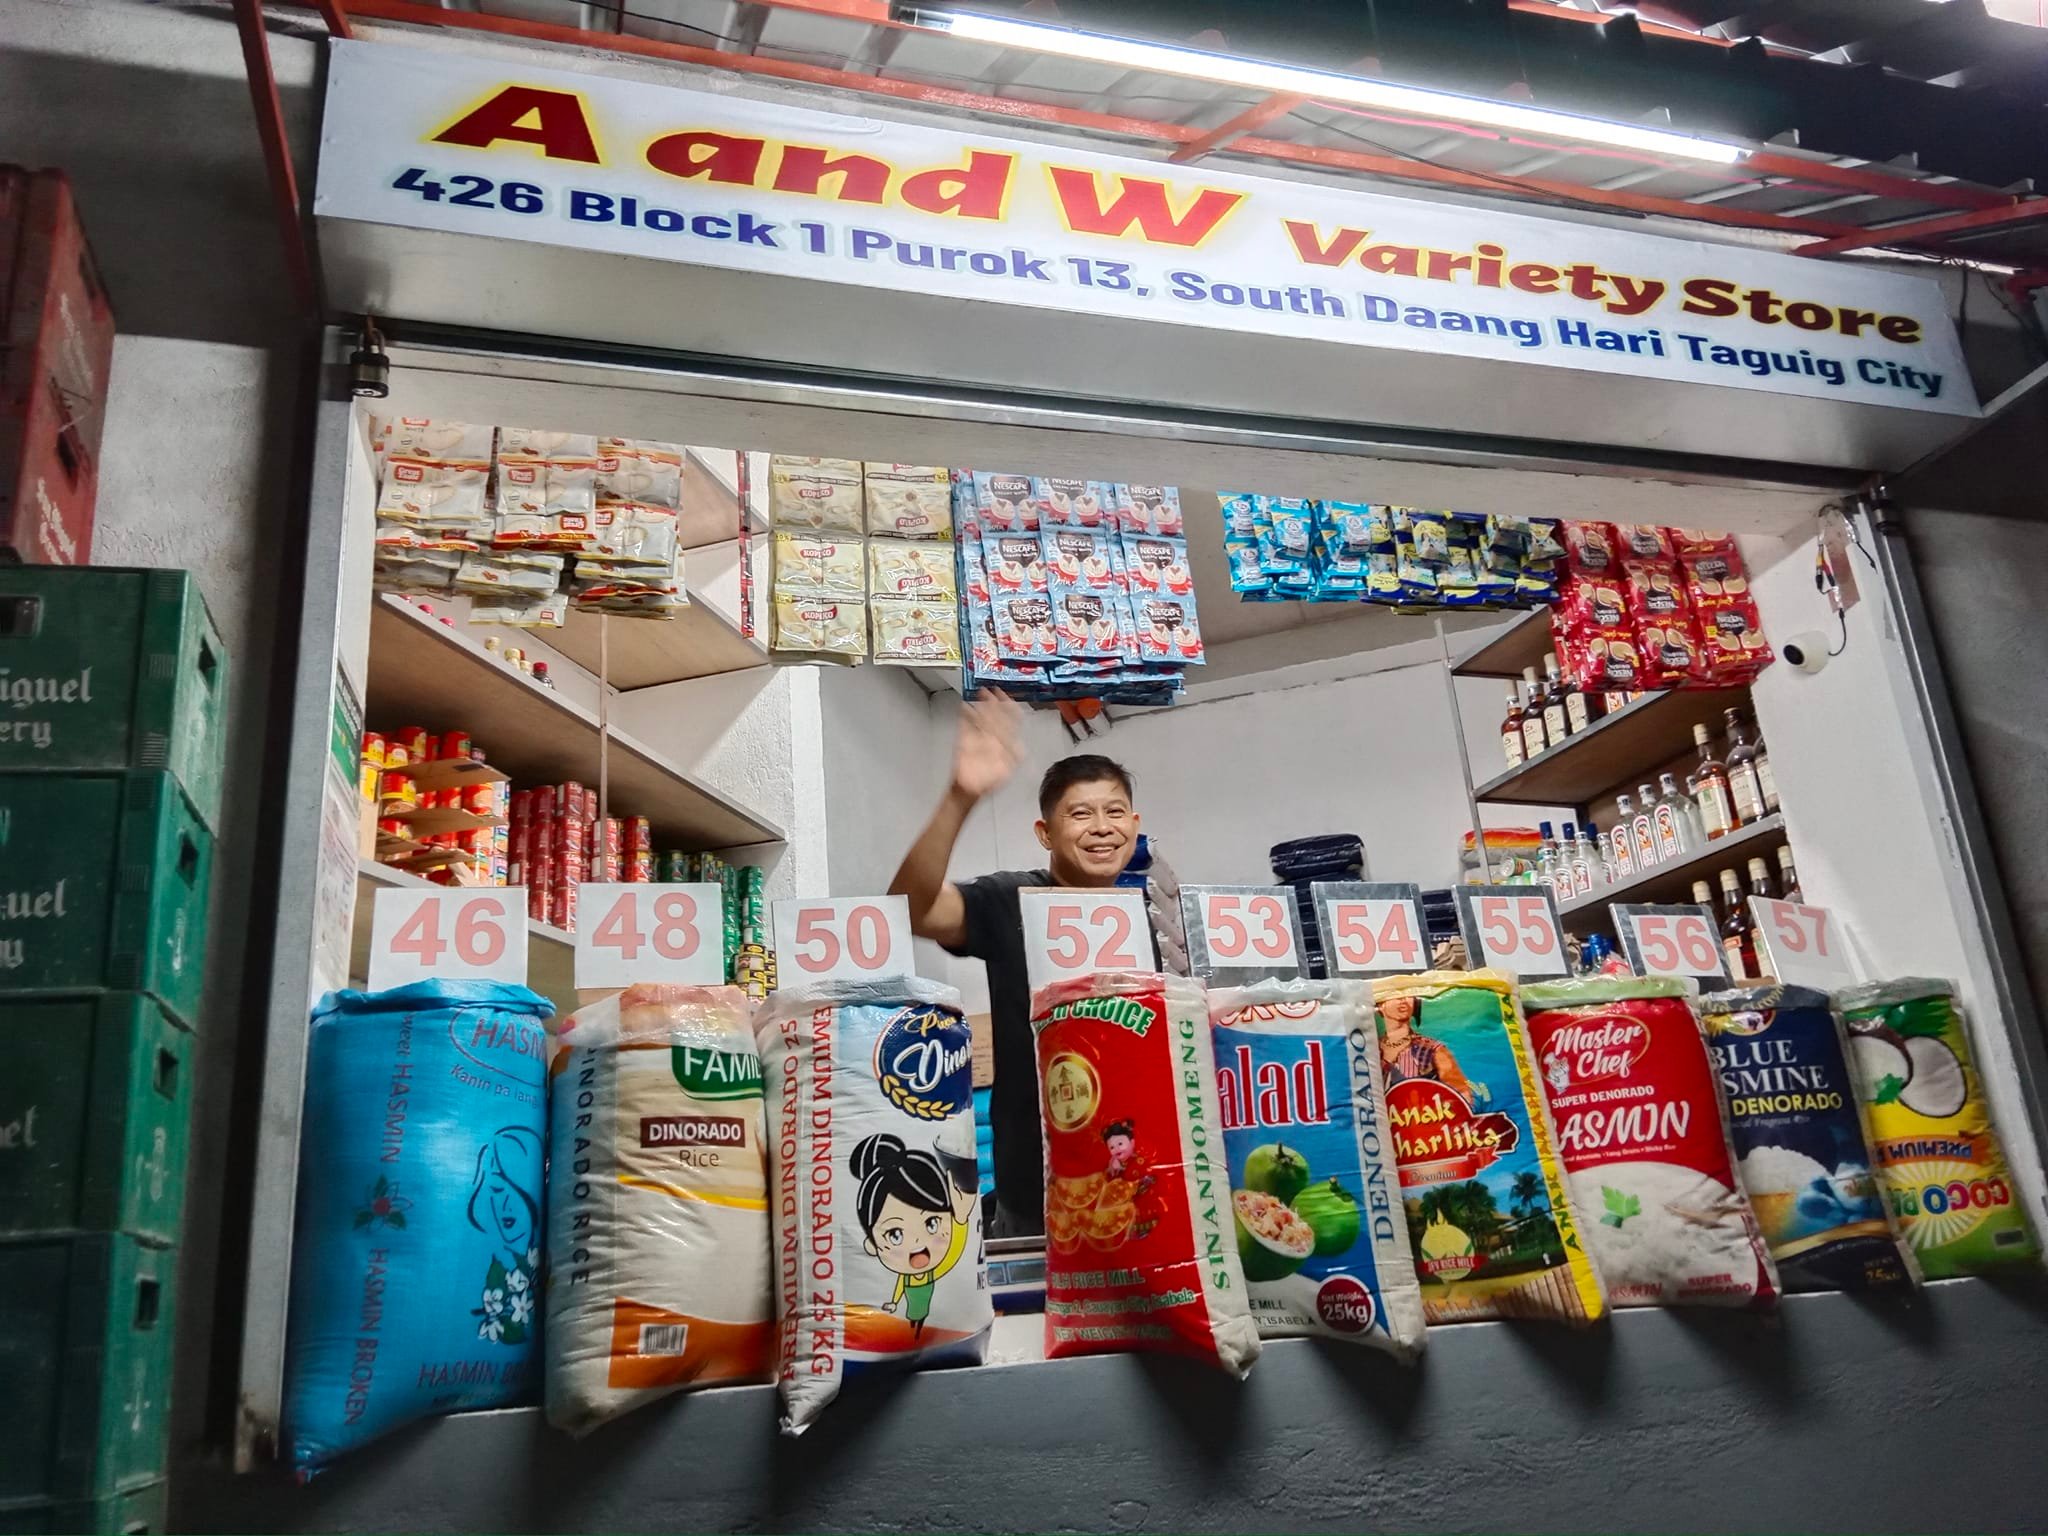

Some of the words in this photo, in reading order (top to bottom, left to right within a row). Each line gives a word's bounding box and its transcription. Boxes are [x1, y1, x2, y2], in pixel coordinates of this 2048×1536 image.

[433, 85, 600, 163] A
[646, 131, 1015, 220] and
[1050, 166, 1247, 247] W
[1283, 218, 1667, 316] Variety
[1682, 278, 1921, 344] Store
[392, 167, 545, 215] 426
[570, 192, 778, 248] Block
[800, 221, 827, 254] 1
[853, 232, 1048, 282] Purok
[1068, 257, 1150, 299] 13,
[1171, 269, 1345, 318] South
[1364, 294, 1542, 348] Daang
[1560, 318, 1665, 357] Hari
[1678, 334, 1845, 387] Taguig
[1857, 358, 1942, 399] City
[390, 898, 506, 966] 46
[592, 893, 700, 960] 48
[795, 904, 891, 973] 50
[1046, 906, 1137, 968] 52
[1208, 895, 1291, 957] 53
[1337, 903, 1418, 963] 54
[1481, 897, 1555, 955] 55
[1640, 917, 1718, 971] 56
[1770, 902, 1828, 957] 57
[1552, 1020, 1644, 1056] Master
[1576, 1049, 1633, 1078] Chef
[1711, 1040, 1797, 1069] BLUE
[380, 1064, 414, 1163] HASMIN
[1389, 1093, 1456, 1128] Anak
[1552, 1096, 1588, 1110] SUPER
[1590, 1084, 1655, 1102] DENORADO
[1732, 1092, 1843, 1116] DENORADO
[649, 1122, 741, 1142] DINORADO
[679, 1149, 720, 1167] Rice
[780, 1054, 799, 1217] DINORADO
[1179, 1019, 1231, 1291] SINANDOMENG
[1350, 1028, 1395, 1243] DENORADO
[1395, 1121, 1500, 1159] harlika
[1889, 1140, 1973, 1160] PREMIUM
[811, 1108, 835, 1280] DINORADO
[1923, 1176, 2010, 1215] COCO
[571, 1212, 591, 1287] RICE
[1108, 1266, 1146, 1287] MILL
[360, 1247, 390, 1332] HASMIN
[1258, 1299, 1287, 1310] MILL
[1323, 1303, 1368, 1323] 25kg
[344, 1338, 380, 1426] BROKEN
[416, 1359, 499, 1388] HASMIN
